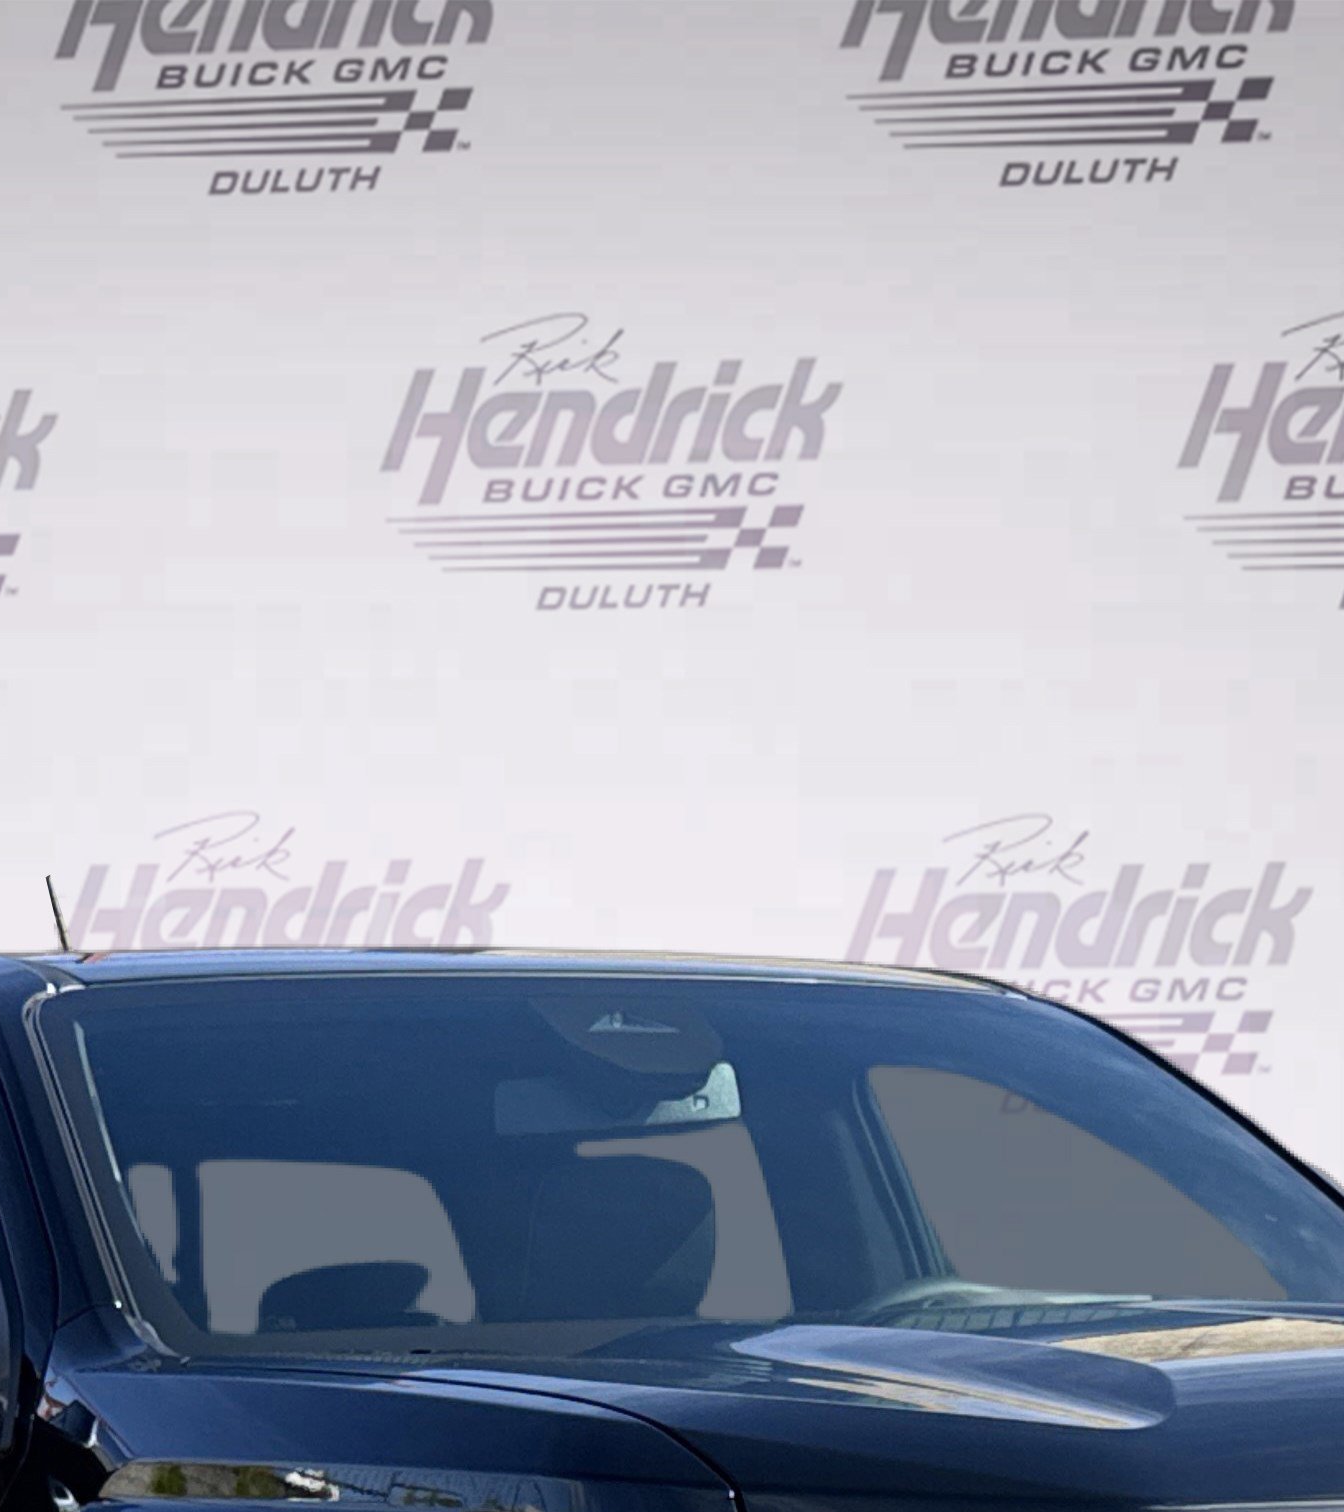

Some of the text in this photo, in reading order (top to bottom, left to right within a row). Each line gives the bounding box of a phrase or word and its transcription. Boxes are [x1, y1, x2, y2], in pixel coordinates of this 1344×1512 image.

[155, 54, 449, 90] BUICK GMC
[944, 43, 1249, 80] BUICK GMC
[208, 165, 382, 196] DULUTH
[998, 156, 1179, 188] DULUTH
[380, 357, 843, 505] Hendrick
[482, 472, 779, 503] BUICK GMC
[536, 583, 711, 611] DULUTH
[844, 861, 1313, 967] Hendrick
[1130, 976, 1248, 1002] GMC
